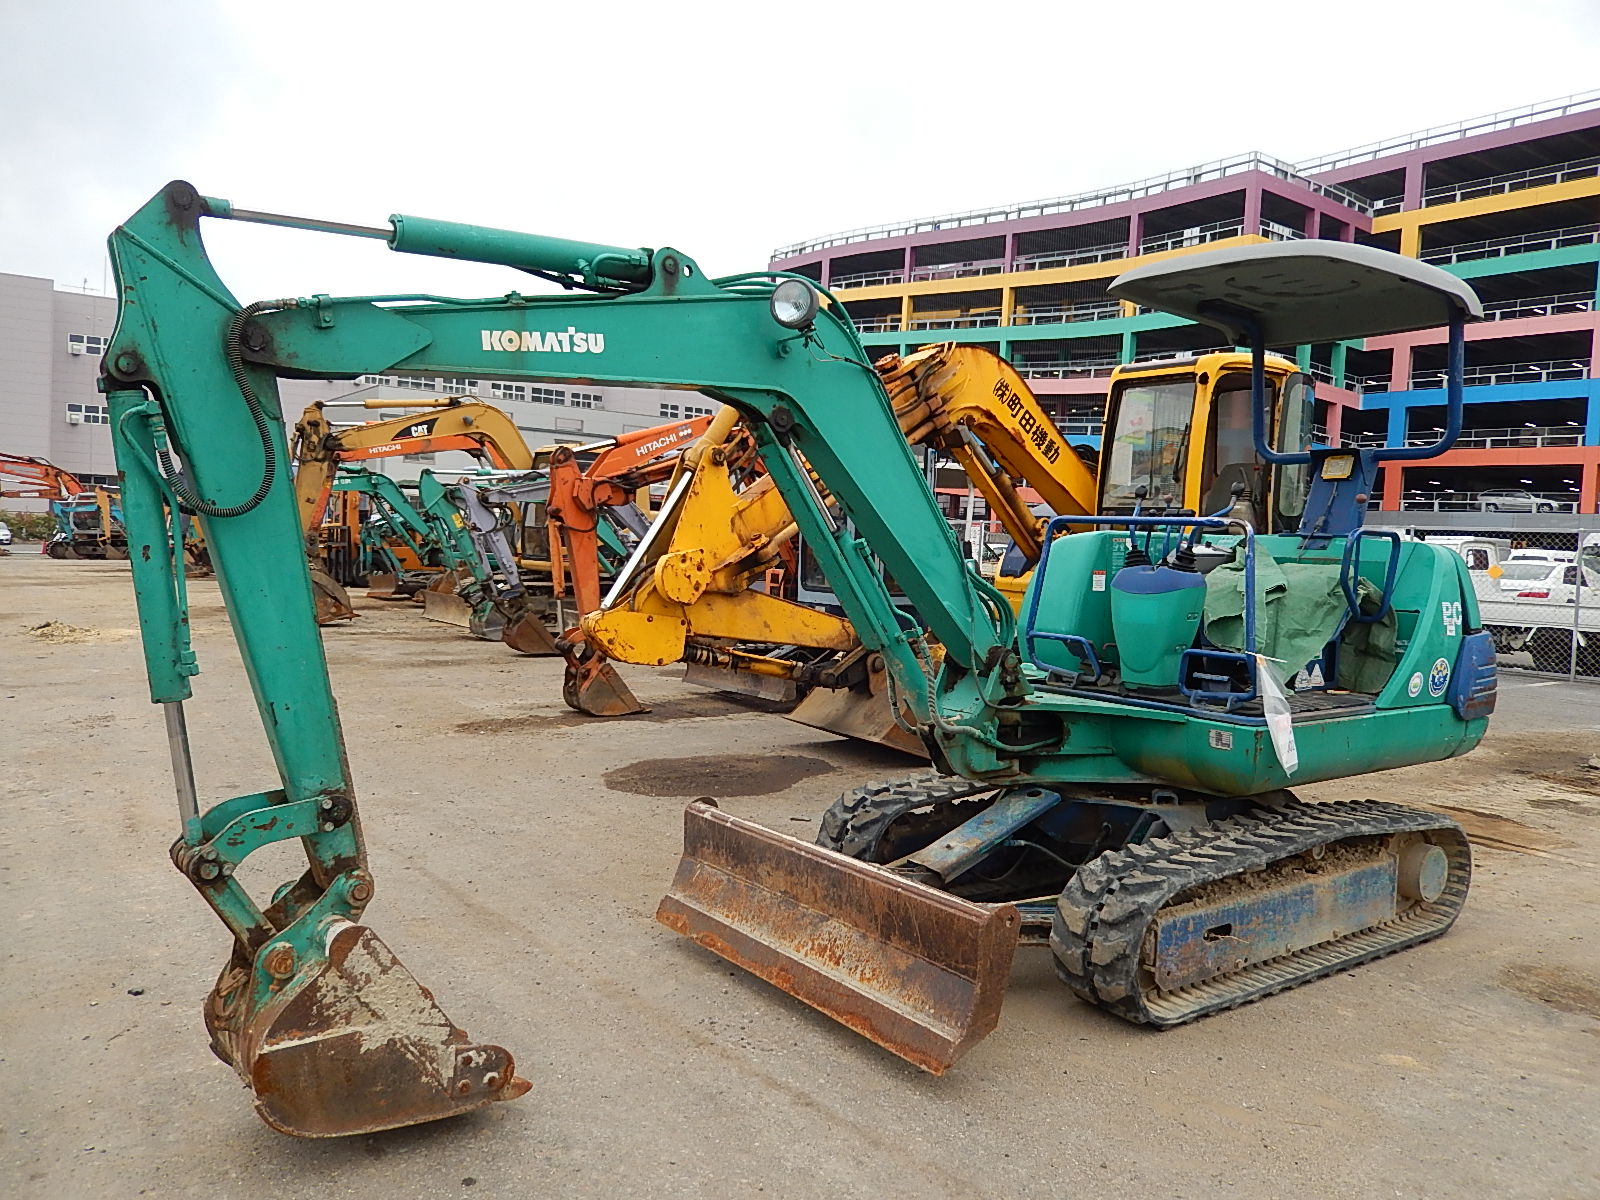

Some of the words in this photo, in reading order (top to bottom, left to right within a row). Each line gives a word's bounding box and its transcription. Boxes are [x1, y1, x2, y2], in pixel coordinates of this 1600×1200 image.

[481, 326, 605, 354] KOMATSU
[411, 424, 429, 438] CAT
[368, 444, 402, 454] HITACHI
[635, 433, 678, 457] HITACHI
